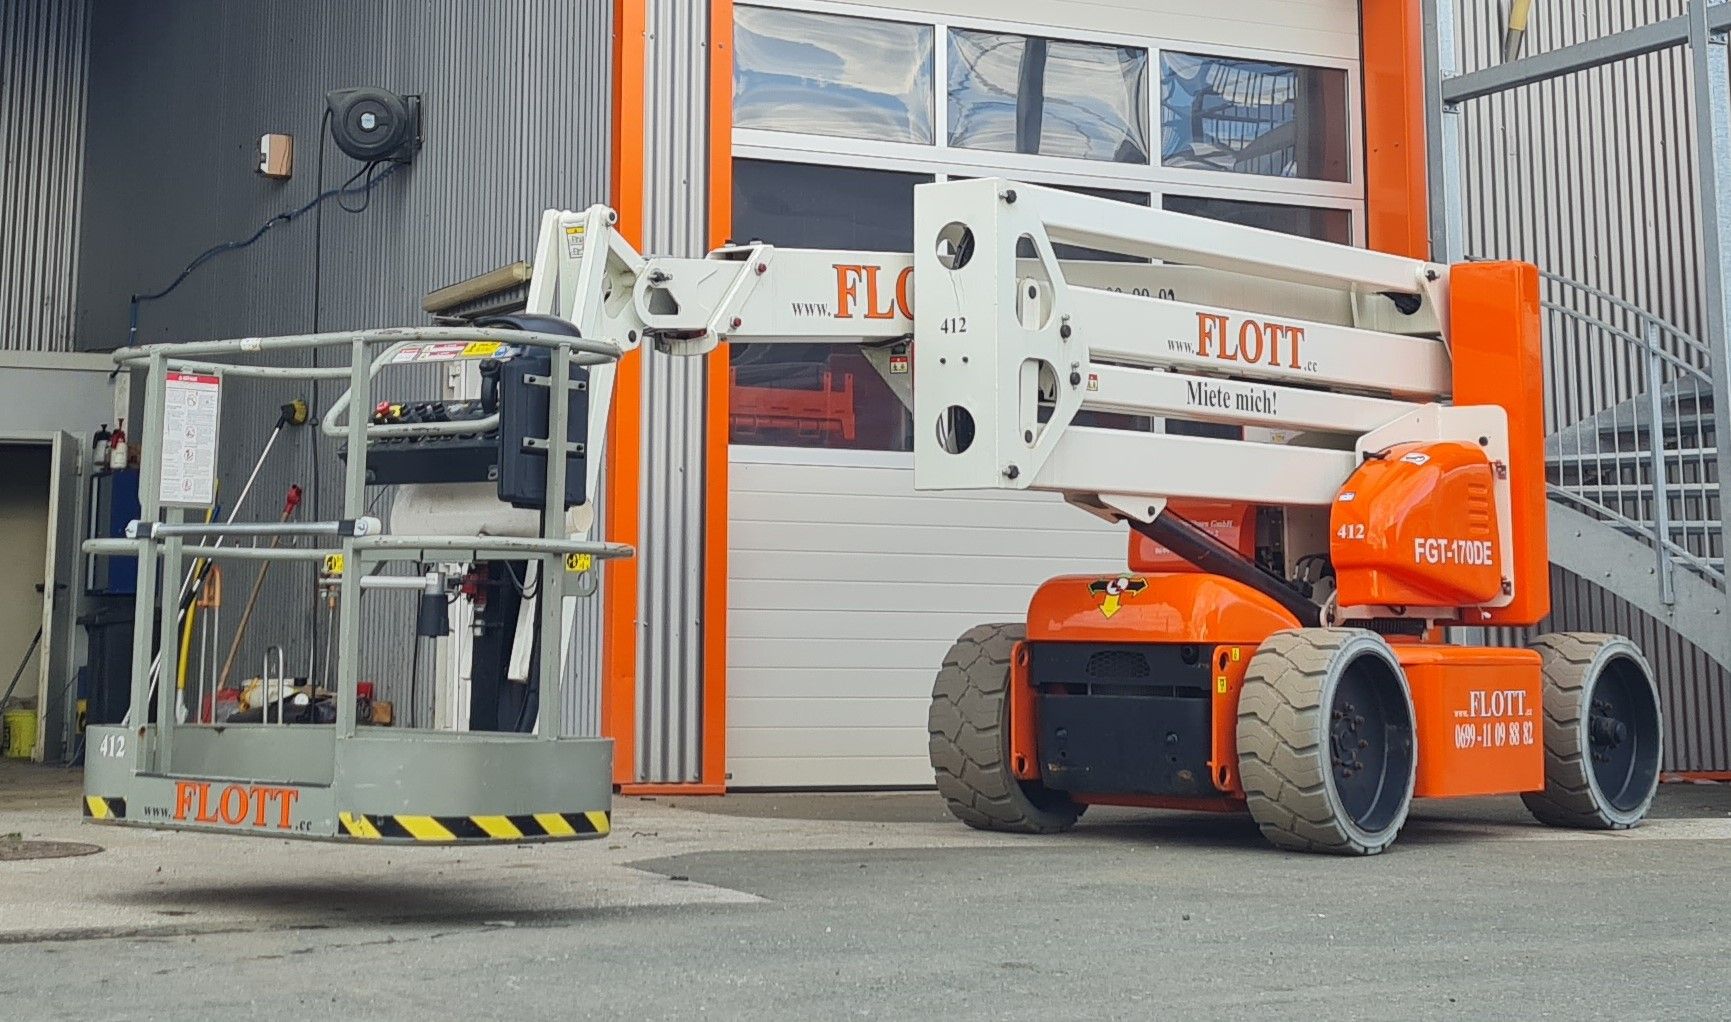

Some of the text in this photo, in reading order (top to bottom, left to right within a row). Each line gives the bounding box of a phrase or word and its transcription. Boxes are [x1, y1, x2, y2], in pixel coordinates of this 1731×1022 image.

[940, 317, 967, 334] 412
[1168, 312, 1318, 372] www.FLOTT.cc
[1186, 380, 1277, 415] Miete mich!
[1337, 524, 1365, 540] 412
[1414, 537, 1493, 566] FGT-170DE
[99, 735, 125, 758] 412
[1509, 721, 1520, 746] 88
[144, 780, 312, 831] www.FLOTT.cc
